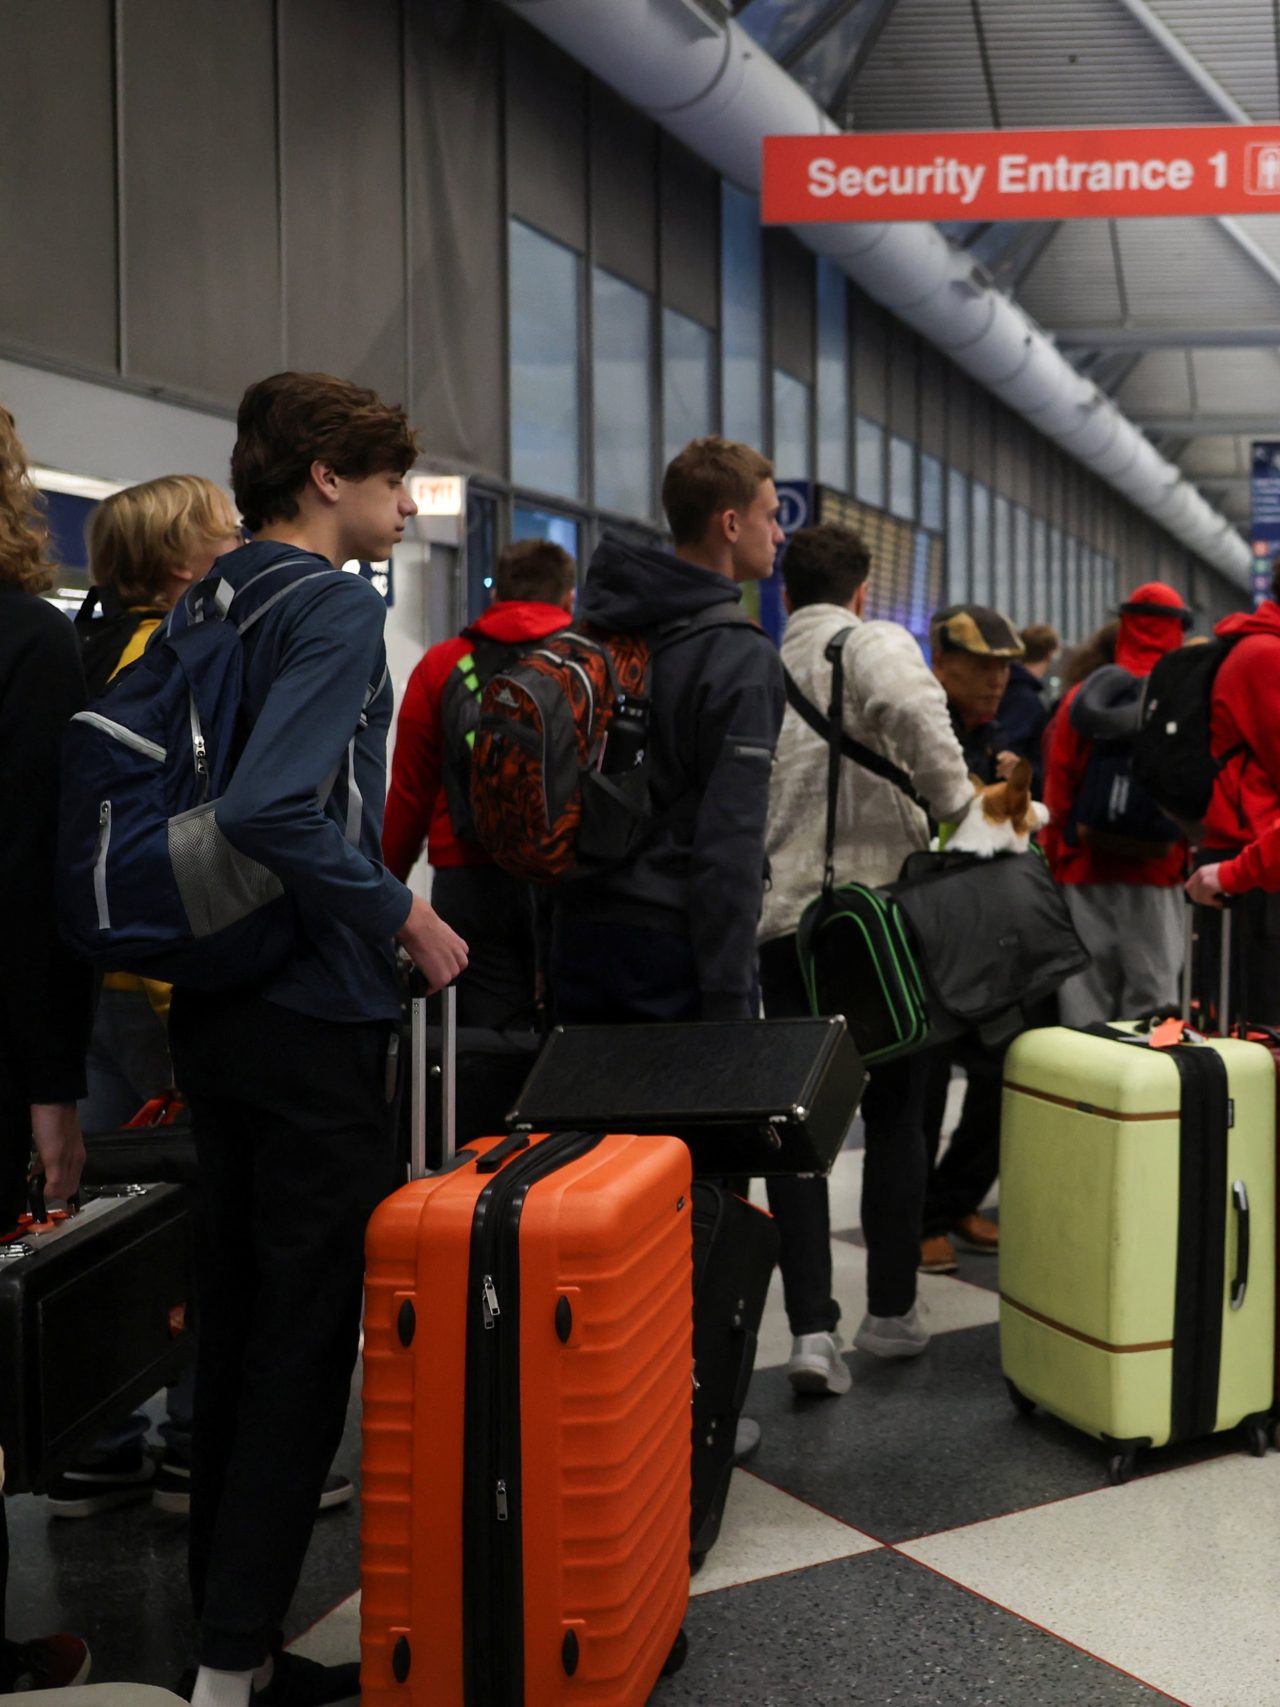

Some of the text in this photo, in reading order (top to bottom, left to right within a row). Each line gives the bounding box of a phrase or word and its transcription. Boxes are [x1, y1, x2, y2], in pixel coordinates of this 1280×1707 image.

[807, 151, 1228, 205] Security Entrance 1
